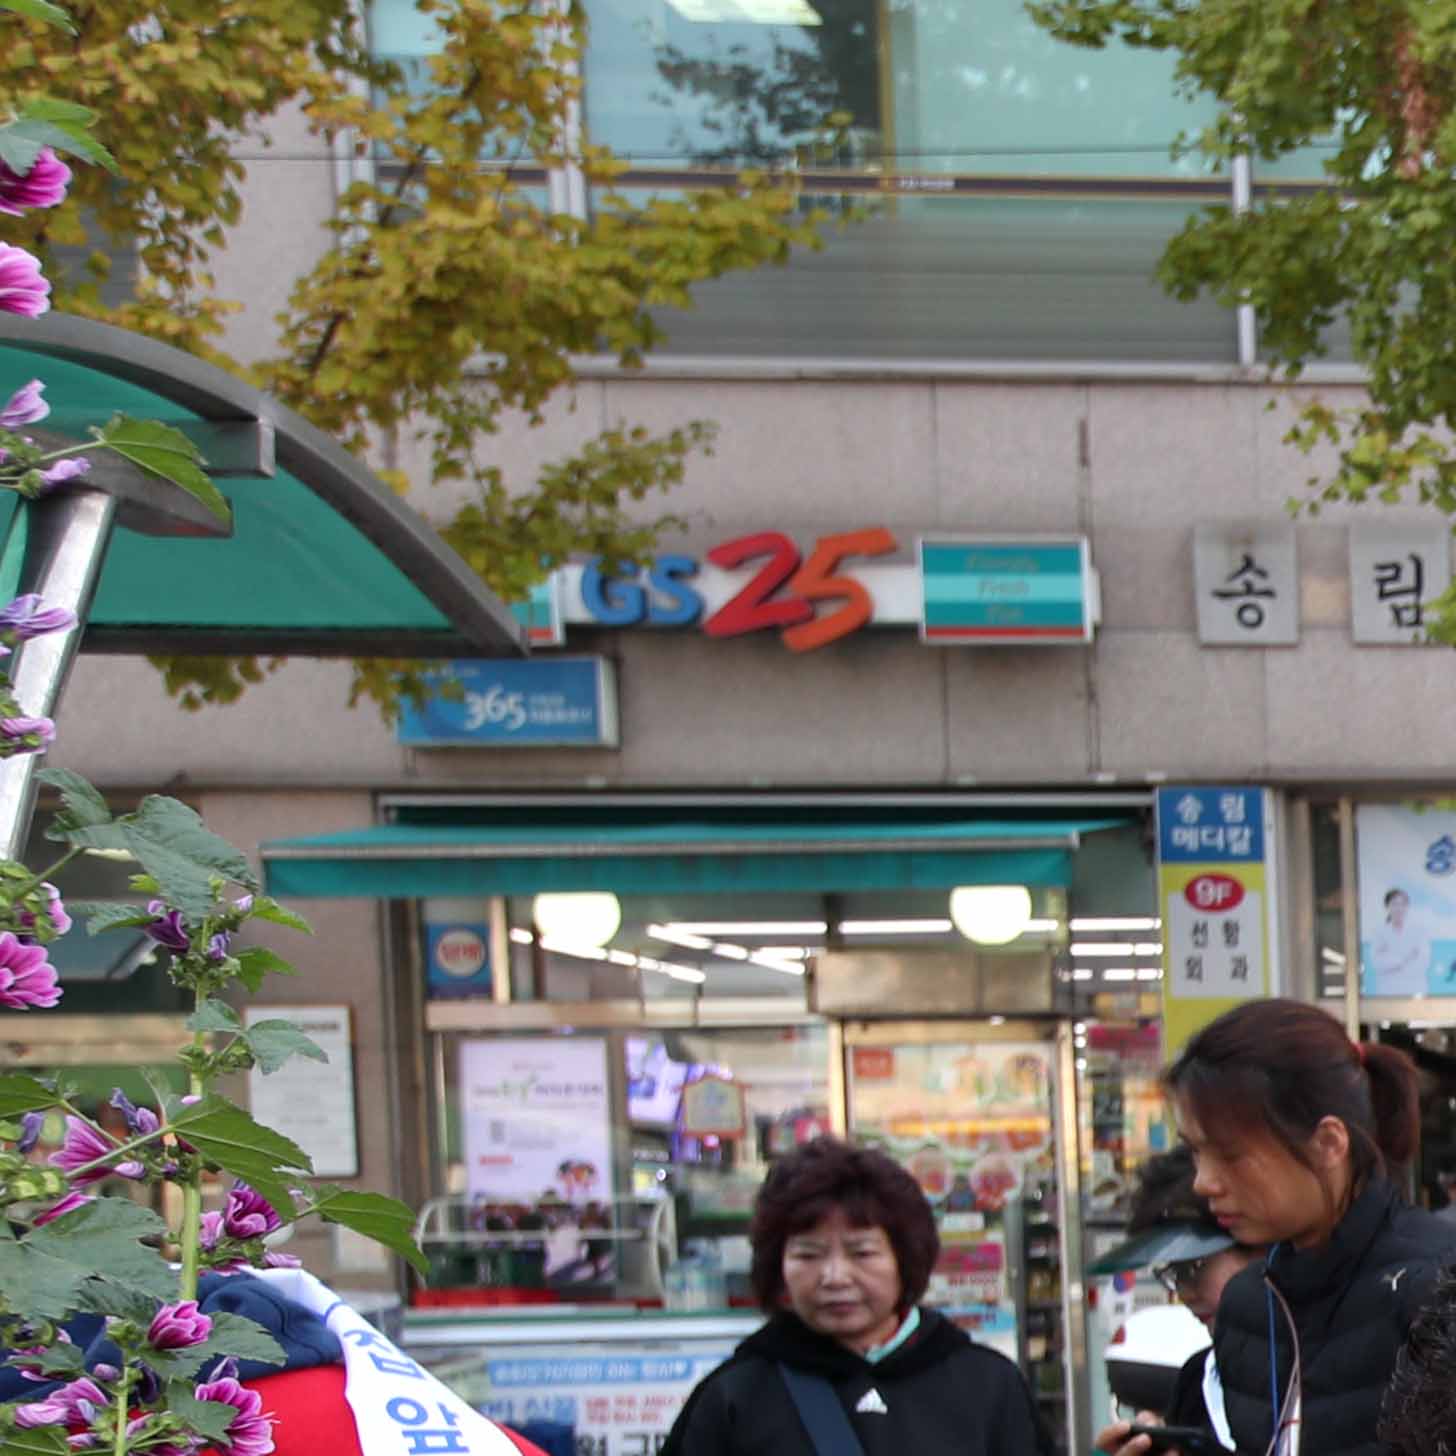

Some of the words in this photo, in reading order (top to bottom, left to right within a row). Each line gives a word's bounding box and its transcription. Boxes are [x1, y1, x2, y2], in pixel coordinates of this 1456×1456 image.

[580, 528, 897, 652] GS25
[463, 683, 527, 731] 365
[1170, 824, 1252, 856] 메디칼
[1194, 877, 1234, 907] 9F
[1185, 954, 1249, 983] 외과
